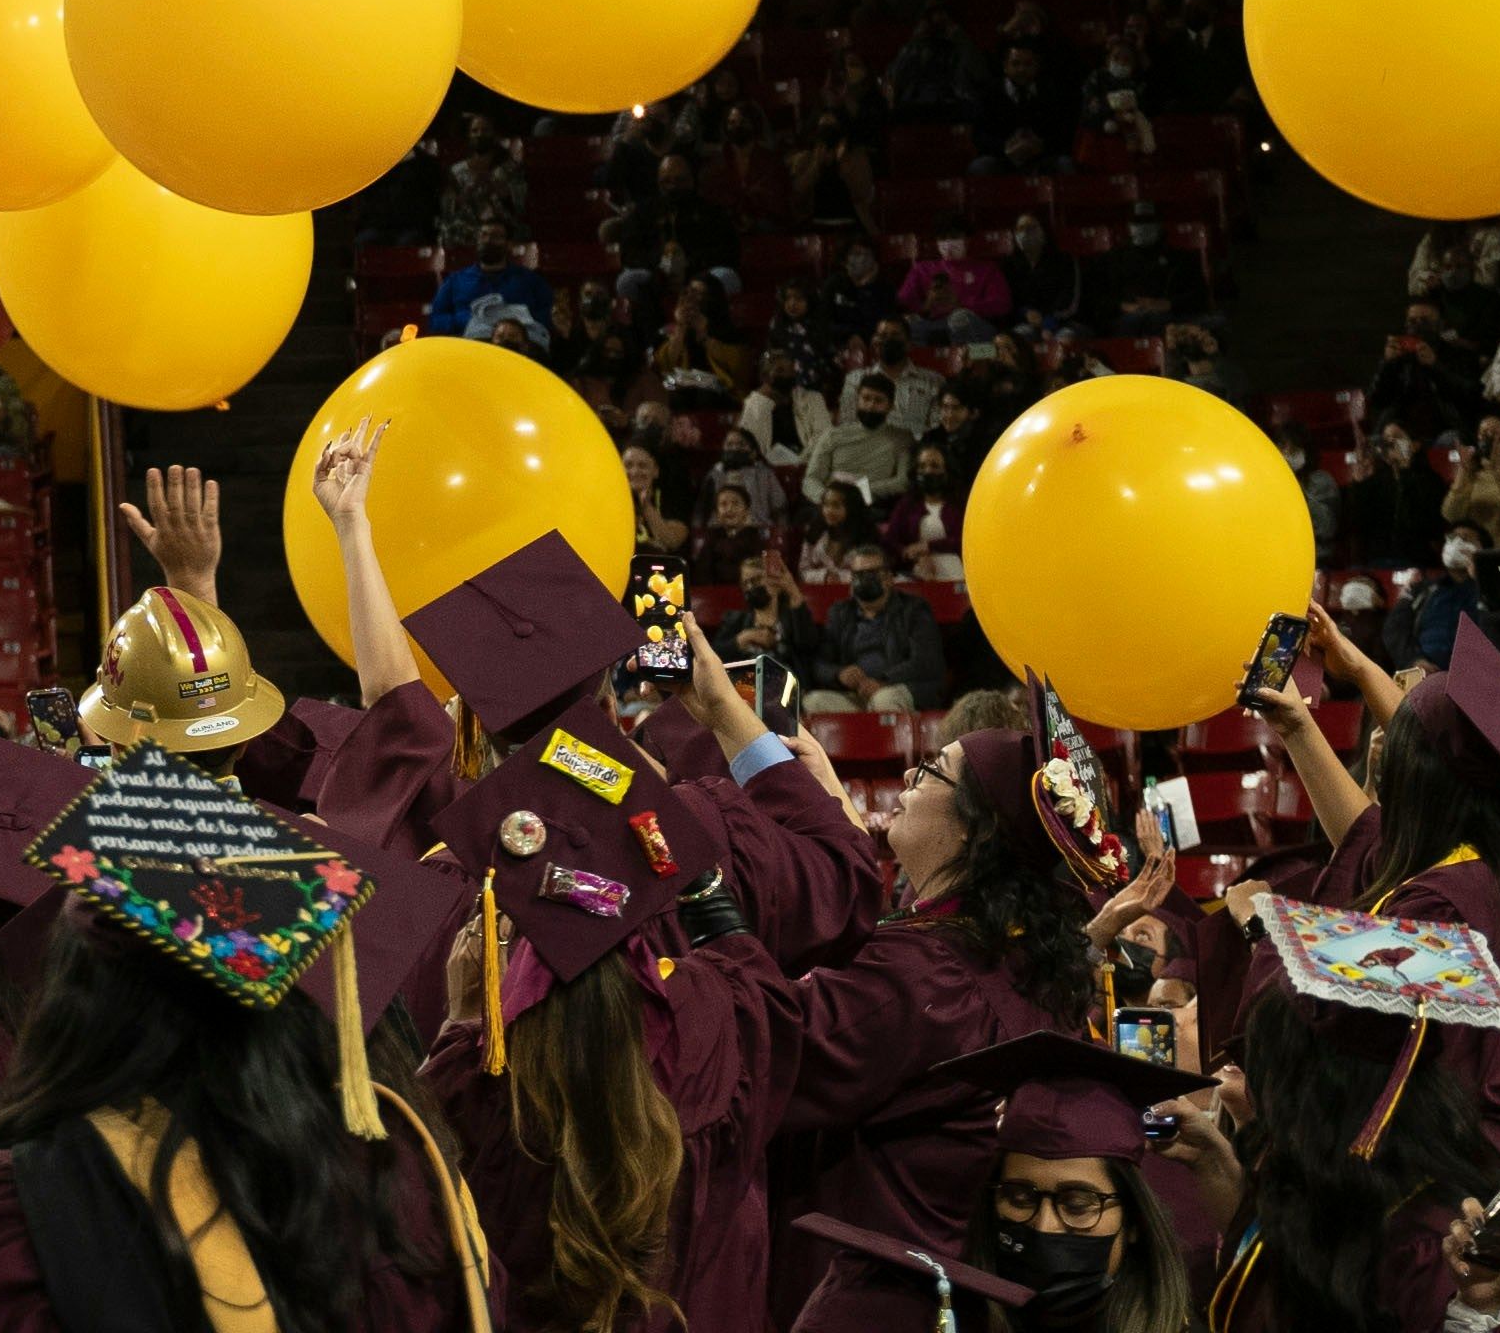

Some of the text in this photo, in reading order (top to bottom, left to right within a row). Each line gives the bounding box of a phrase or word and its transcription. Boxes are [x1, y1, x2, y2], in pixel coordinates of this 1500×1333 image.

[108, 770, 153, 790] final
[156, 772, 186, 790] del
[89, 791, 261, 817] podemos aguantar
[87, 813, 150, 831] mucho
[194, 817, 220, 834] de
[219, 819, 239, 836] lo
[240, 824, 279, 842] que
[89, 834, 184, 855] pensamos
[183, 842, 223, 858] que
